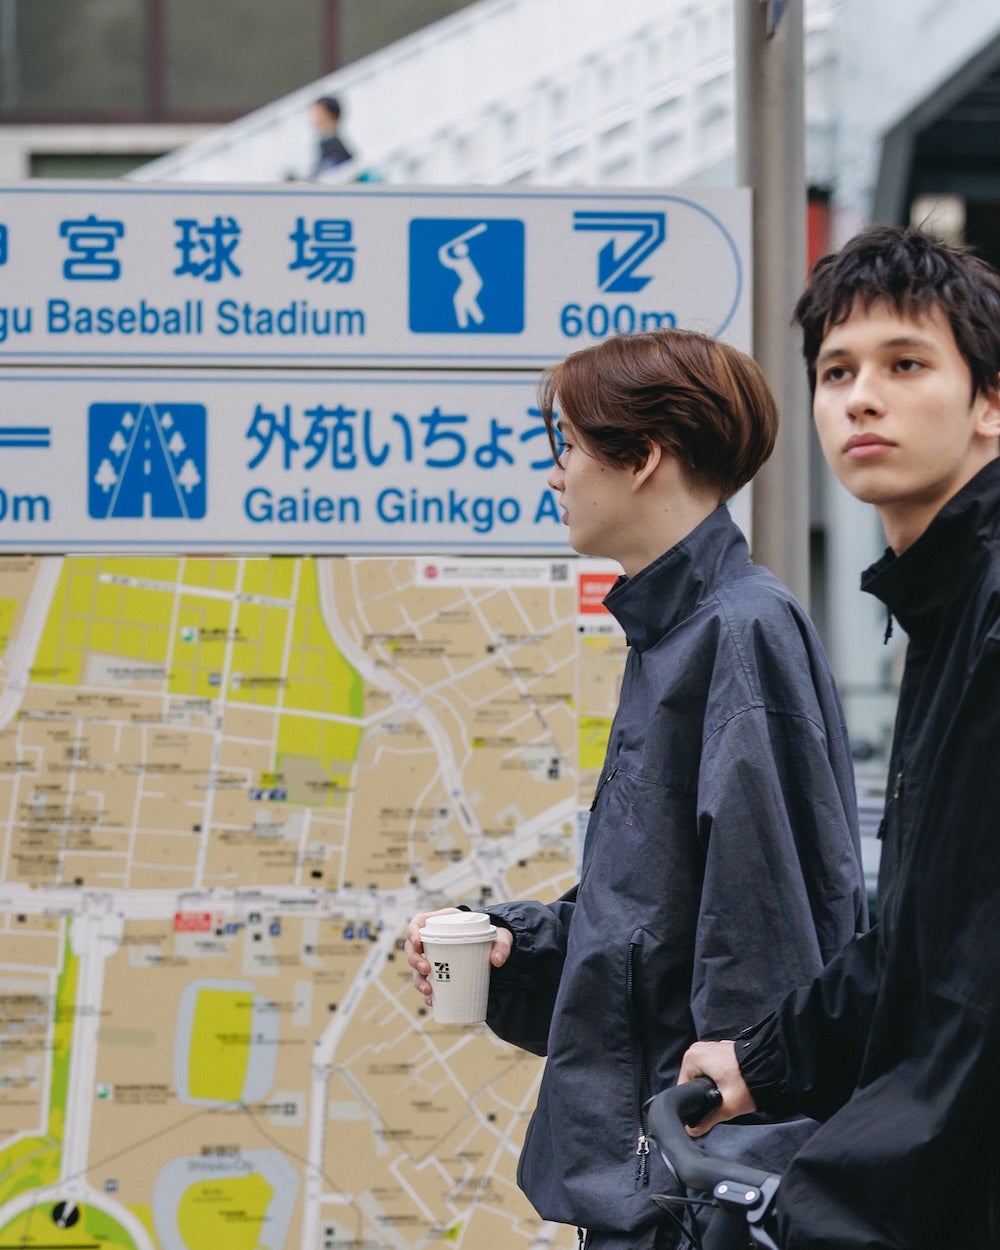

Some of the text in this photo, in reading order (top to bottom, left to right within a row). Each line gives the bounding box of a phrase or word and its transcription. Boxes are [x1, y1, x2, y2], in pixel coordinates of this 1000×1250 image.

[47, 300, 203, 335] Baseball
[216, 300, 366, 335] Stadium
[560, 303, 676, 338] 600m
[244, 488, 360, 524] Gaien
[376, 488, 521, 533] Ginkgo
